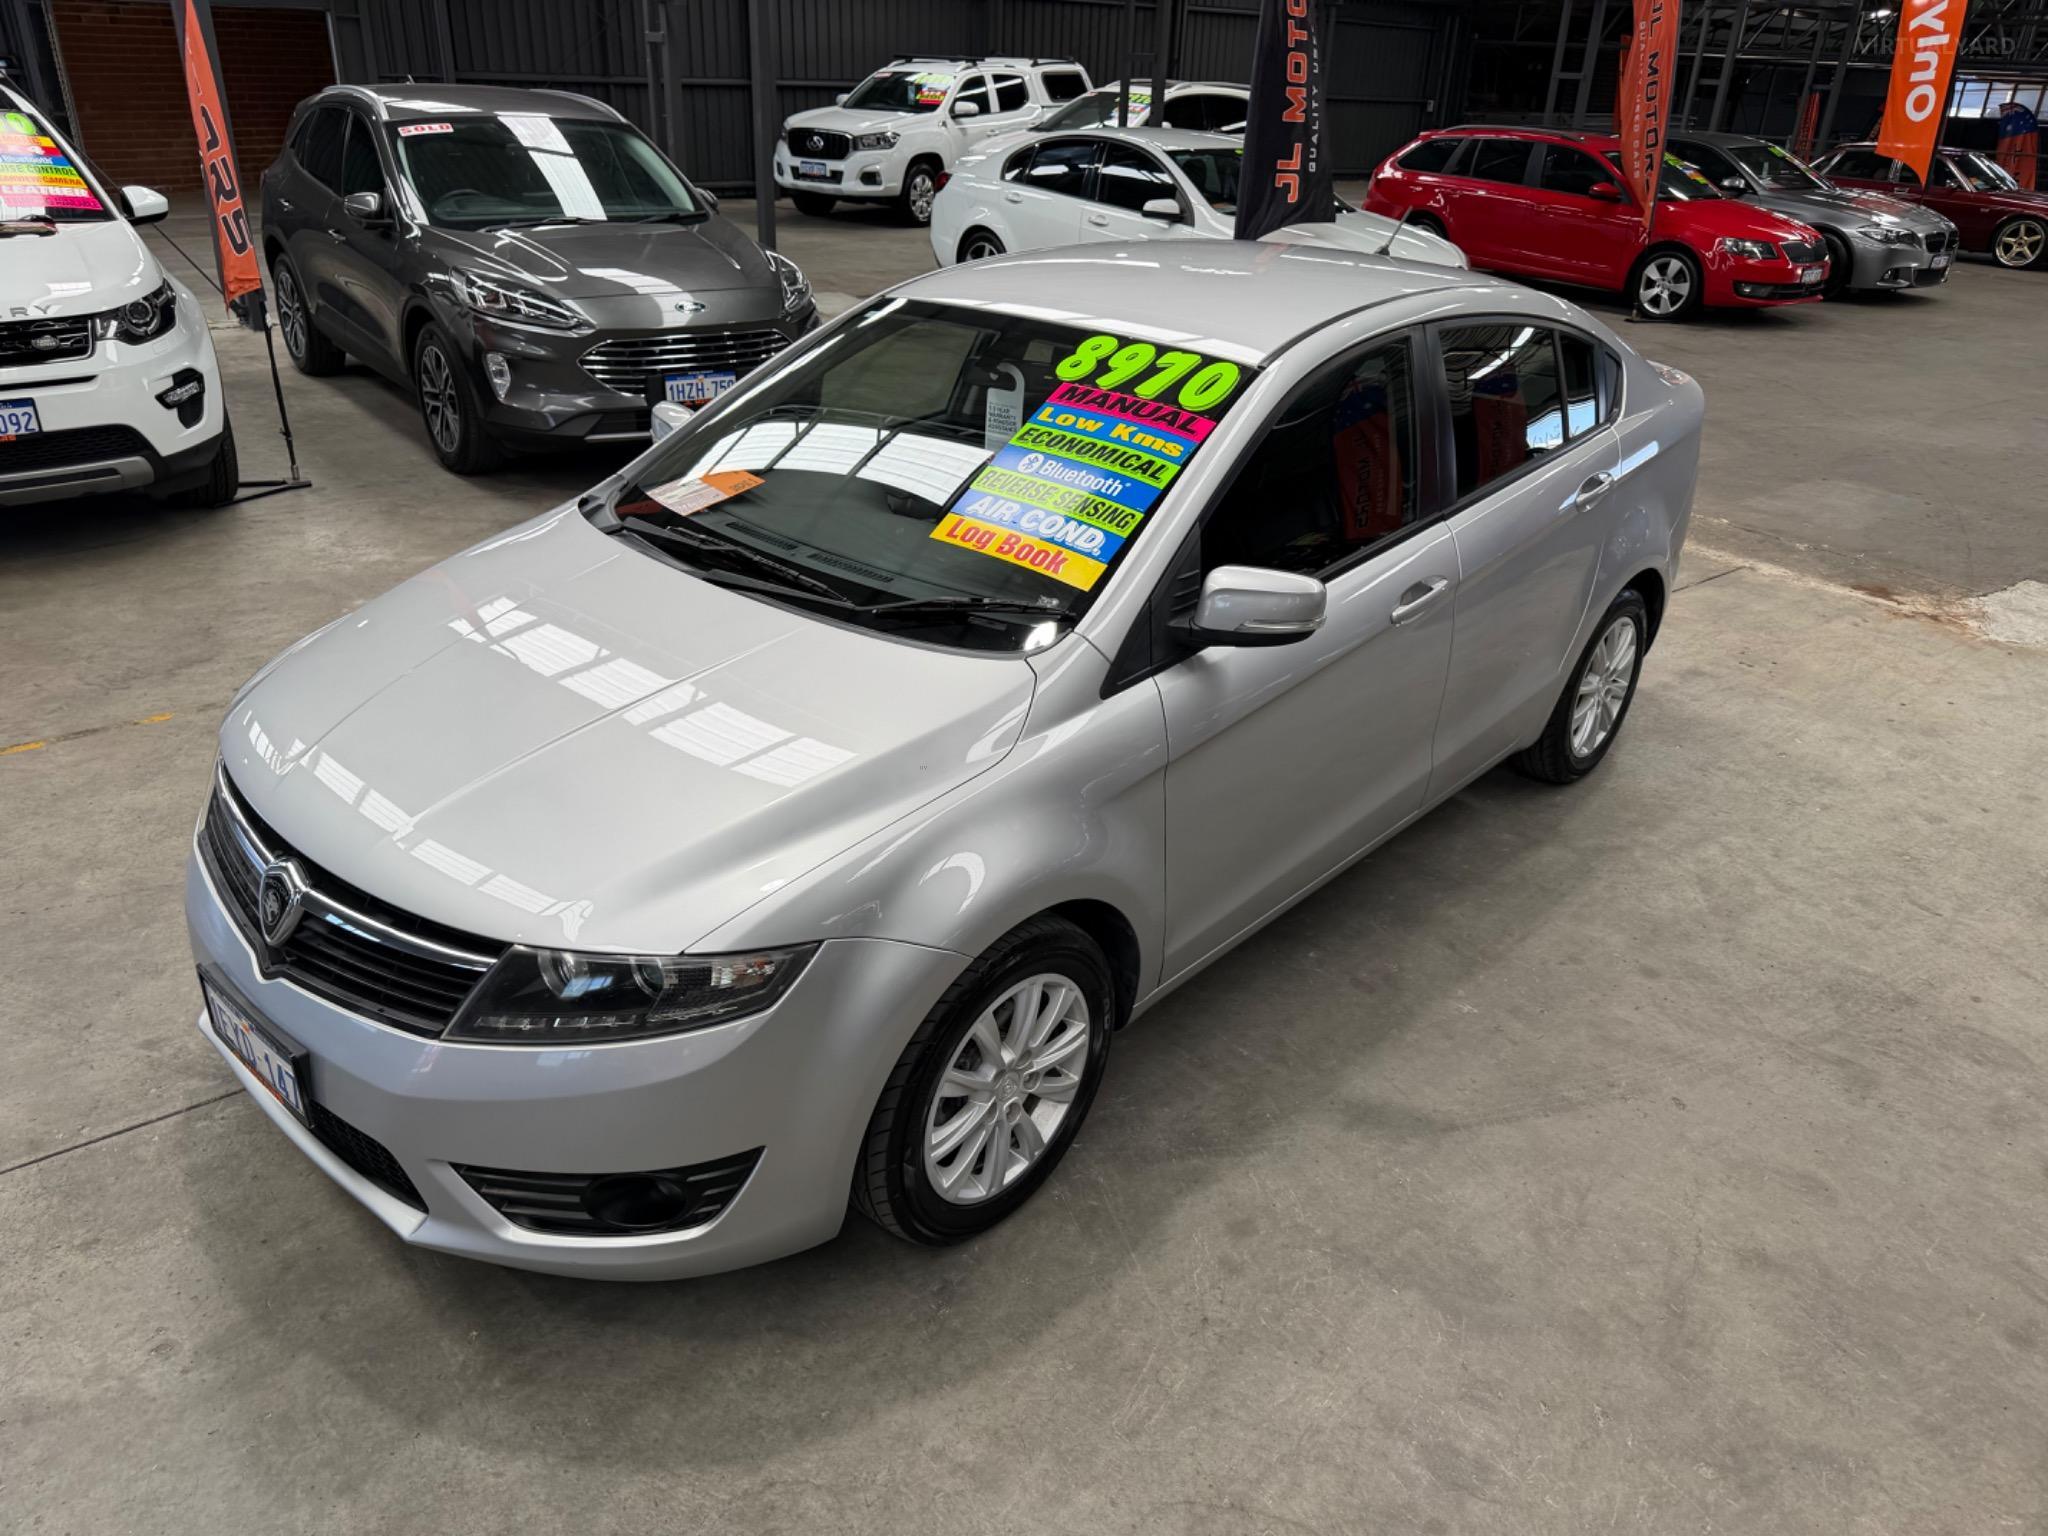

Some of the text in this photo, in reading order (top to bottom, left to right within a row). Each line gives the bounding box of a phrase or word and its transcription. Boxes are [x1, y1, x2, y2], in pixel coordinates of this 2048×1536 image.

[400, 124, 452, 135] SOLD
[1308, 85, 1320, 173] QUALITY
[1643, 51, 1660, 194] MOTOR
[2, 184, 89, 197] LEATHER
[1275, 143, 1303, 203] JL
[1037, 407, 1184, 457] Low Kms
[1059, 385, 1198, 435] MANUAL
[1018, 428, 1169, 482] ECONOMICAL
[1040, 459, 1124, 498] Bluetooth
[965, 496, 1107, 556] AIR COND.
[976, 471, 1136, 531] REVERSE SENSING
[946, 518, 1070, 576] Log Book
